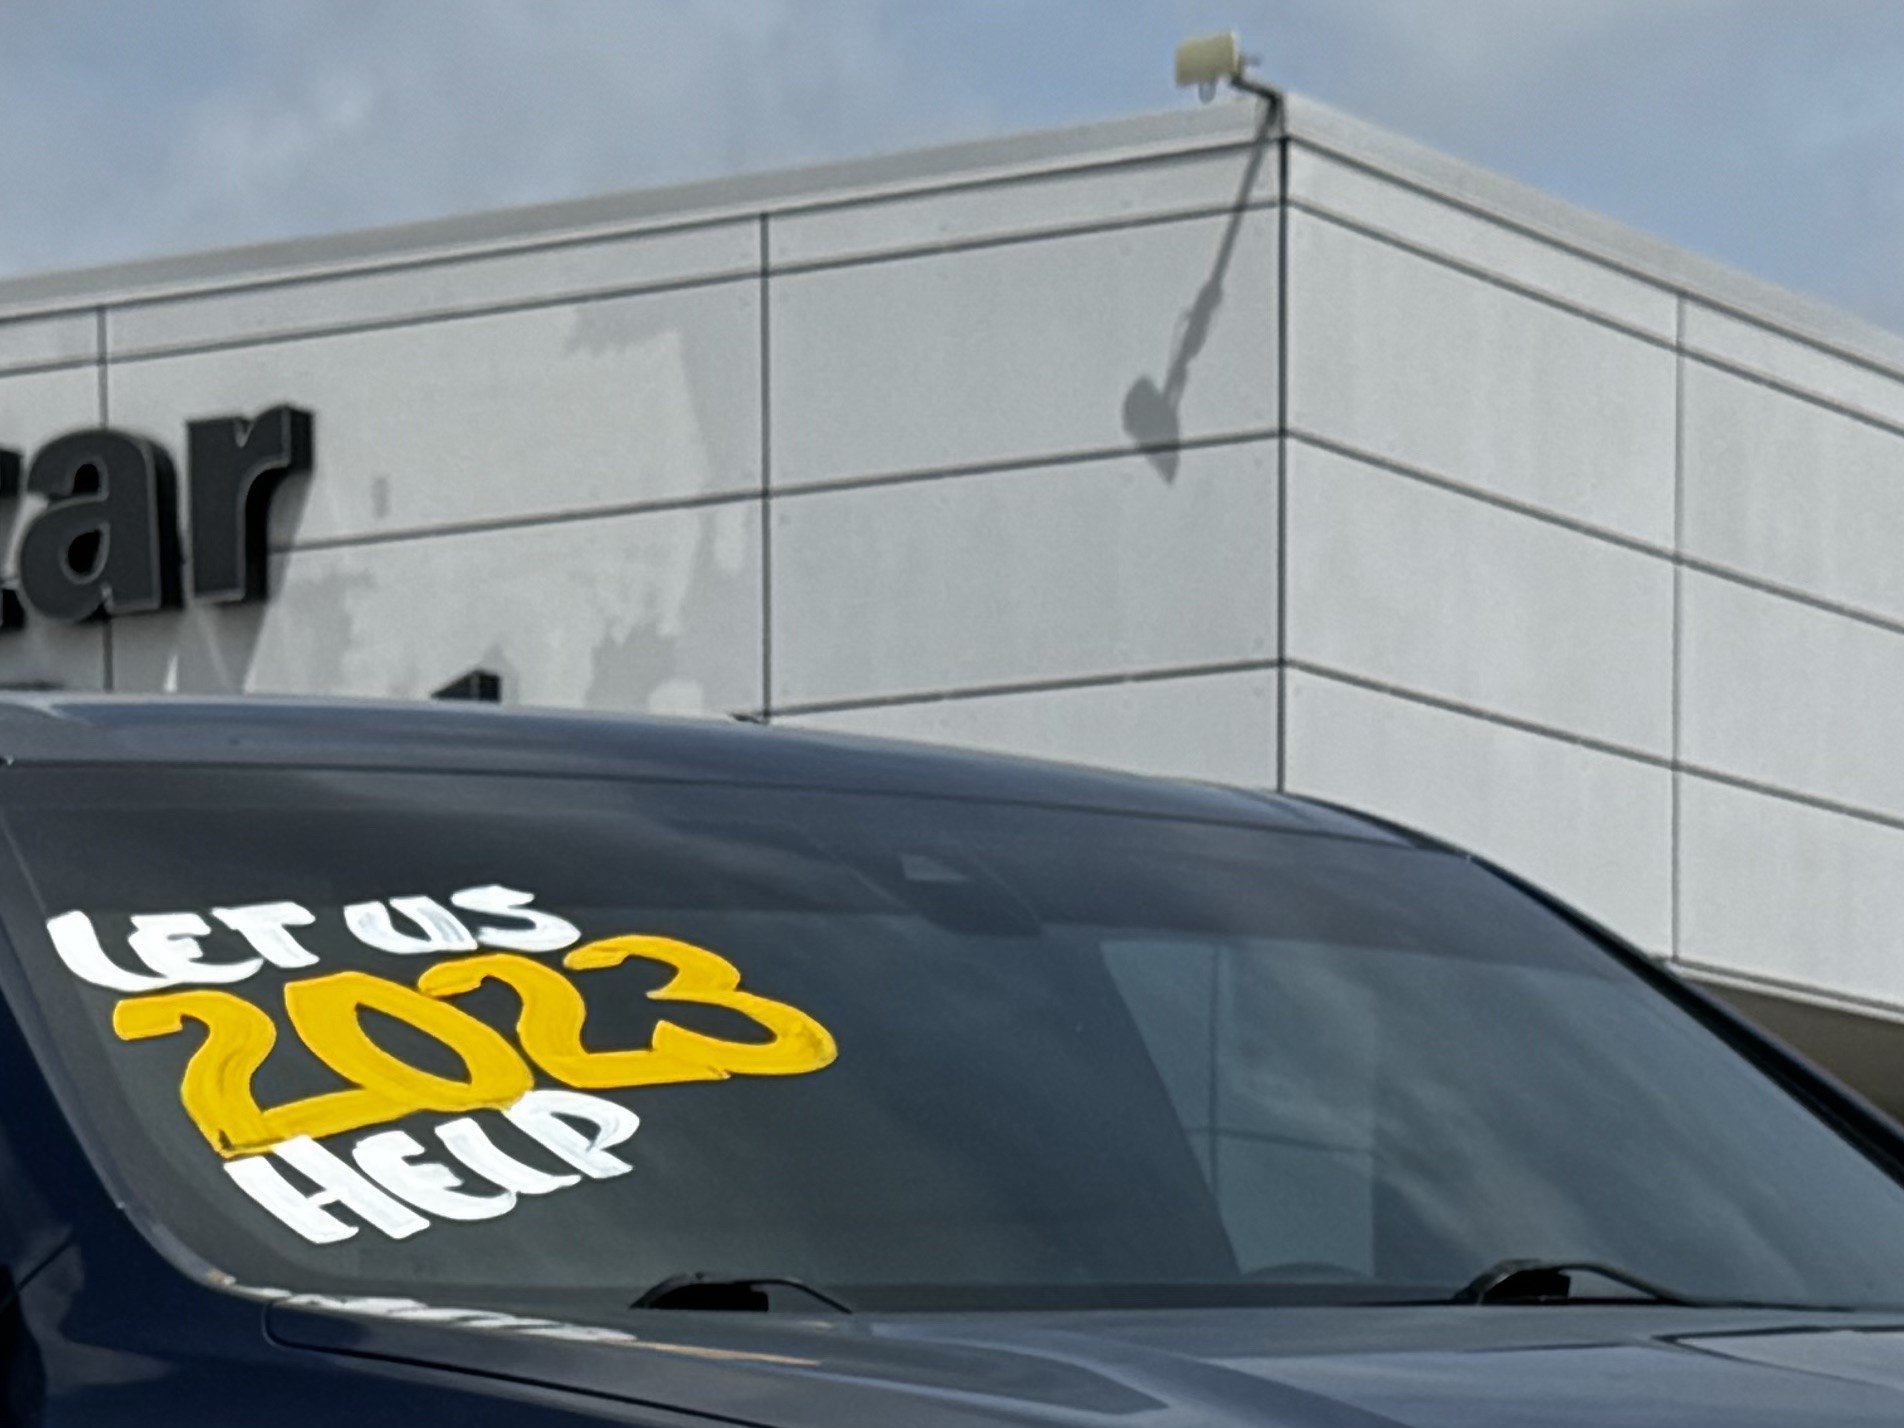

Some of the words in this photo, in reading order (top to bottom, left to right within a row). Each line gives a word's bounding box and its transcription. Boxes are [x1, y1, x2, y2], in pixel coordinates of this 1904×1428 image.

[46, 900, 322, 992] LET
[343, 884, 582, 954] US
[113, 934, 838, 1158] 2023
[224, 1089, 640, 1245] HELP
